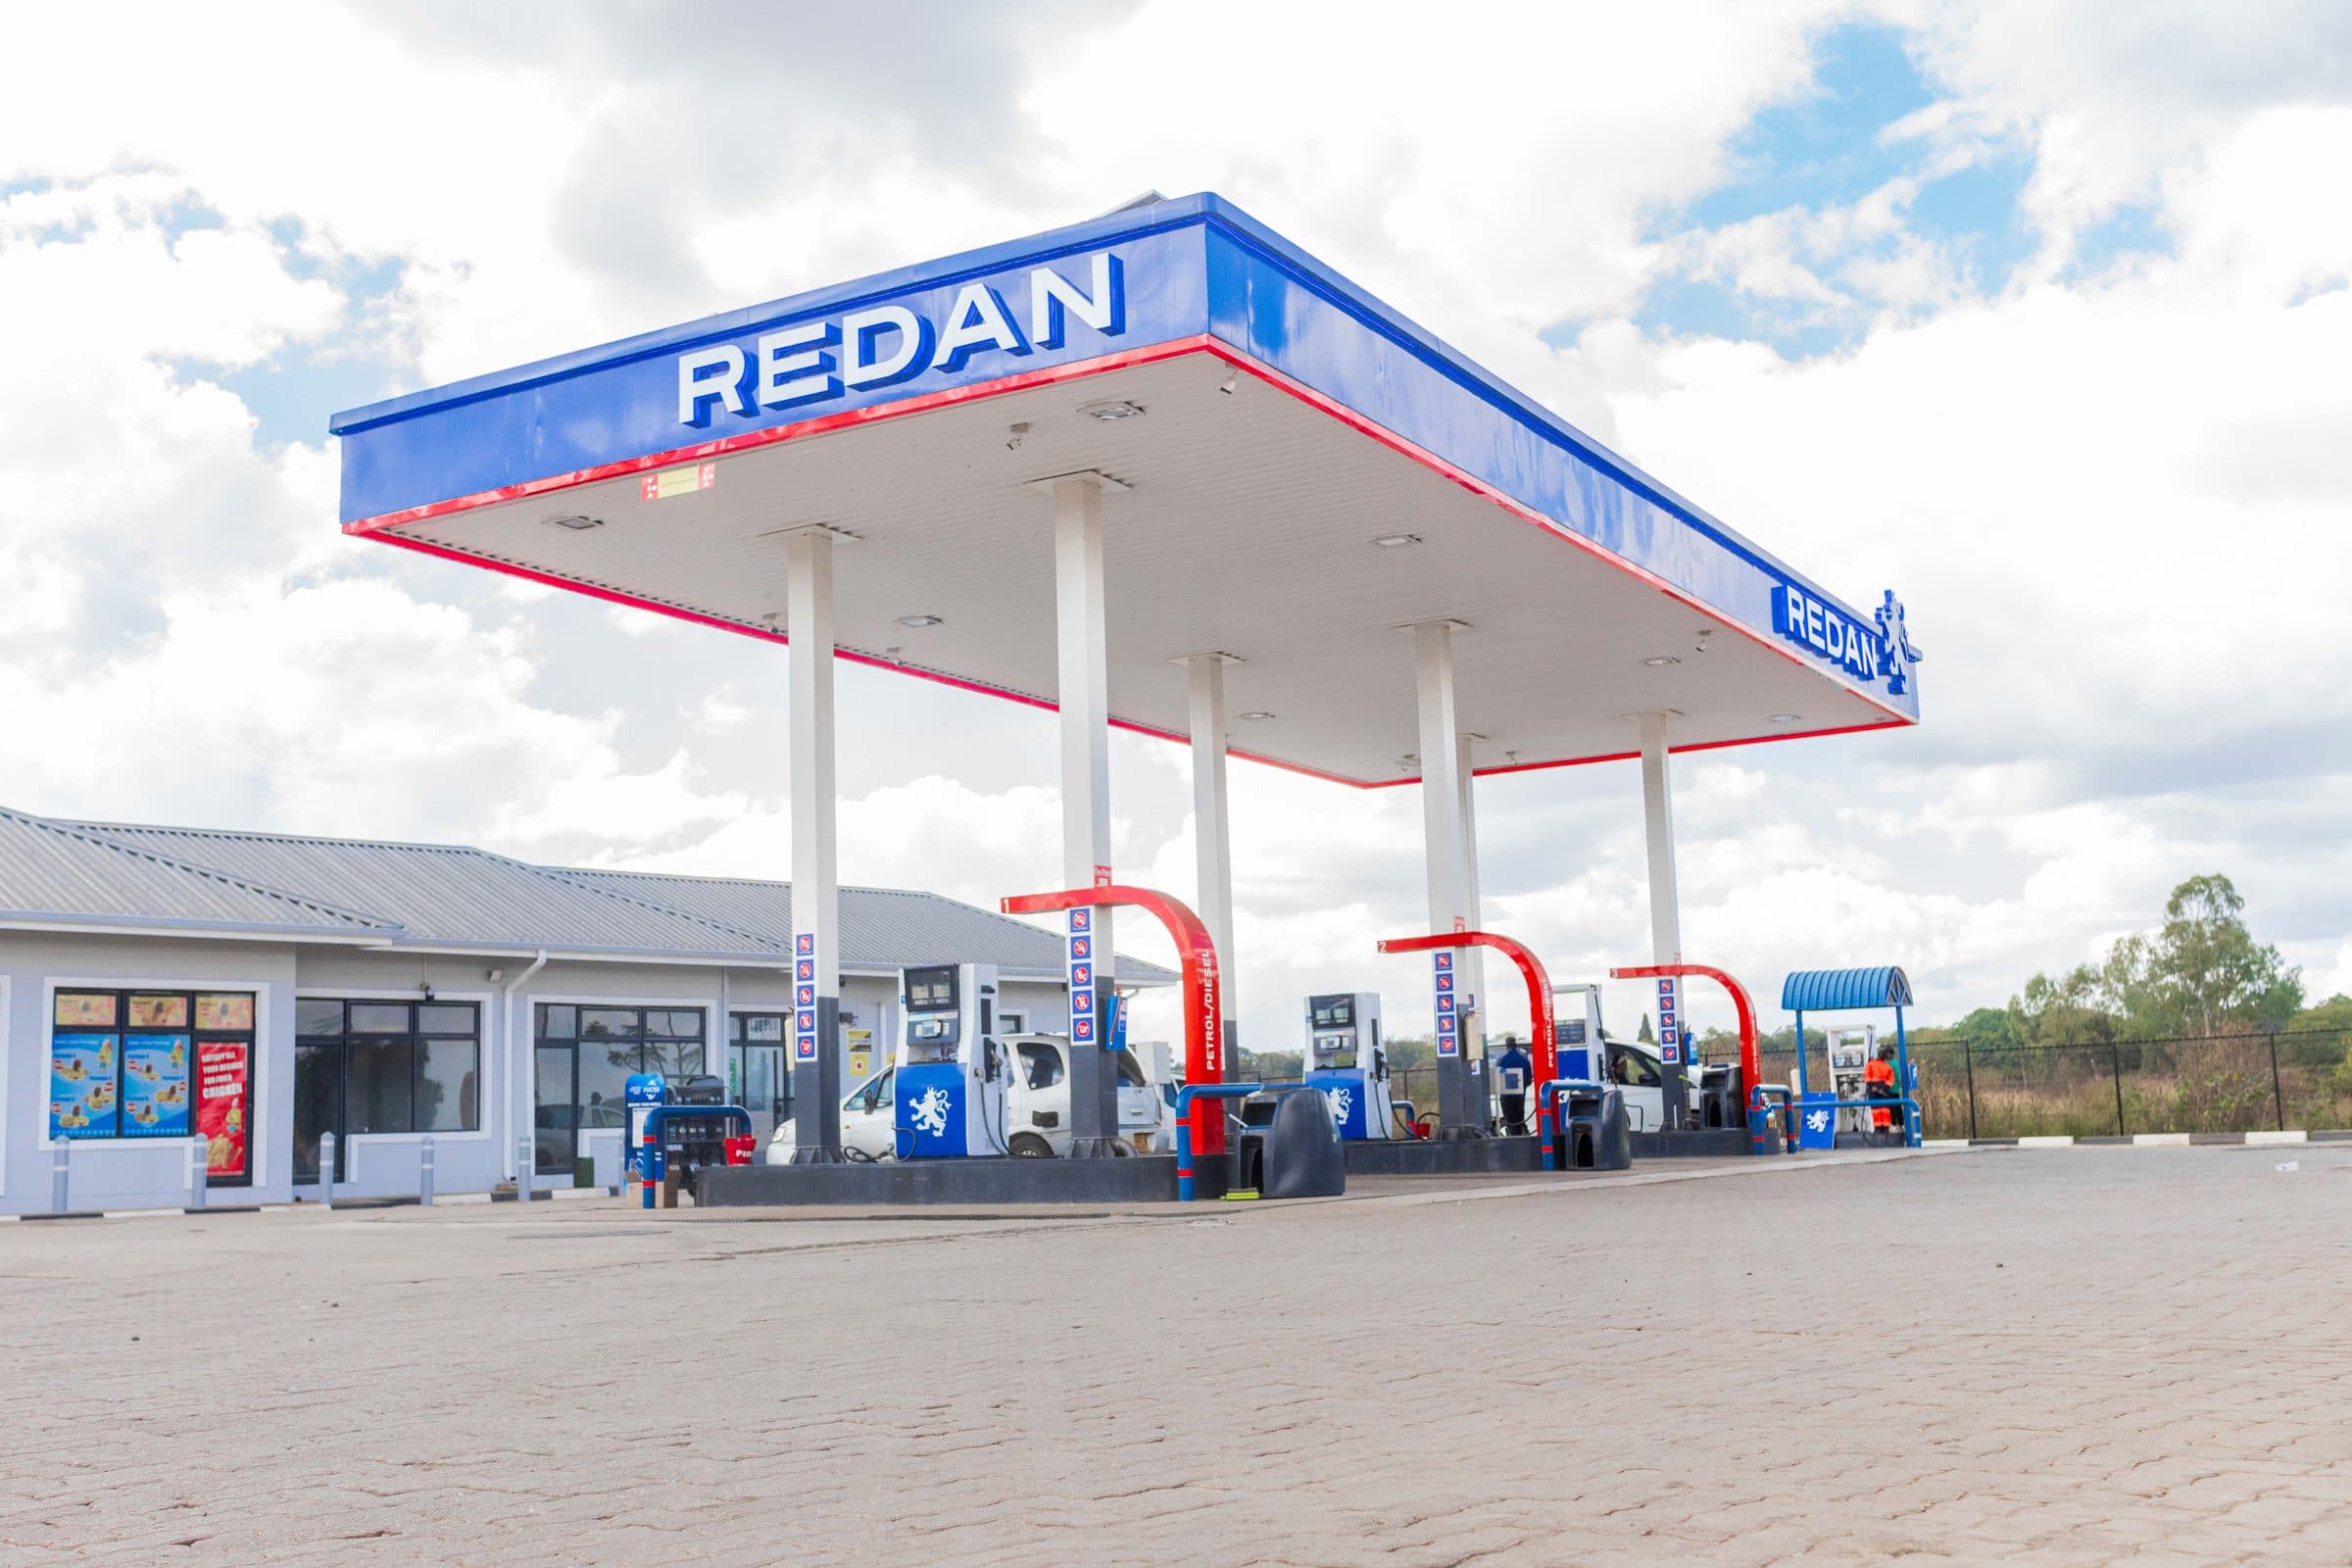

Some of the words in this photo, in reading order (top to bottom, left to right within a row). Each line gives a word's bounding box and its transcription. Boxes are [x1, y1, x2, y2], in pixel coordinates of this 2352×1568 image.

[678, 252, 1125, 428] REDAN
[1786, 586, 1878, 679] REDAN
[1004, 898, 1009, 913] 1
[1379, 941, 1387, 953] 2
[1201, 950, 1215, 1071] PETROL/DIESEL
[203, 1064, 220, 1074] YOUR
[203, 1082, 243, 1099] CHICKEN
